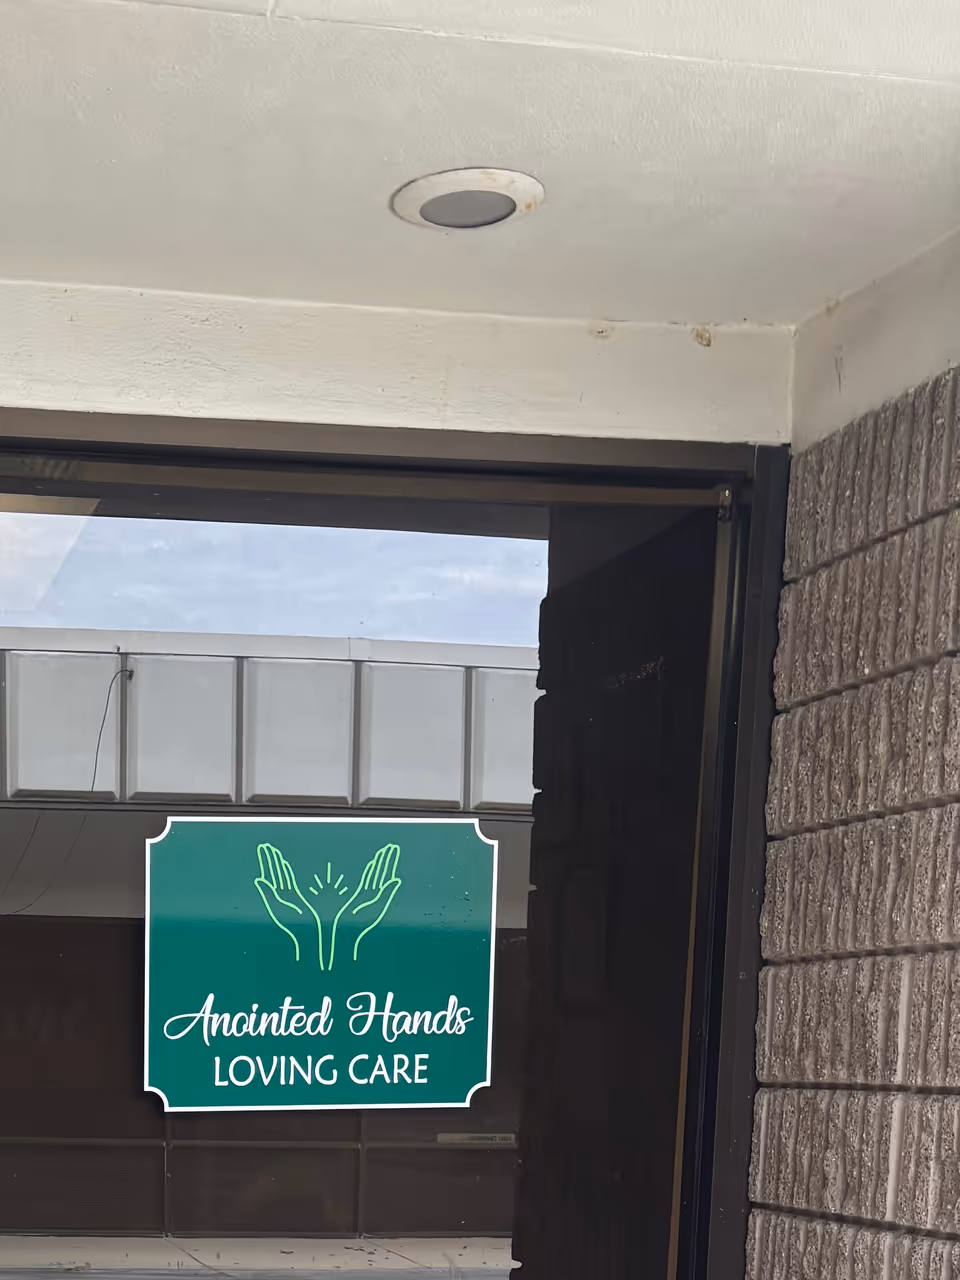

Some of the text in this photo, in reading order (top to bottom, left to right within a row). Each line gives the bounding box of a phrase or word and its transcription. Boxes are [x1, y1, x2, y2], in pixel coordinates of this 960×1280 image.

[163, 991, 475, 1047] Anointed Hands
[214, 1053, 429, 1087] LOVING CARE
